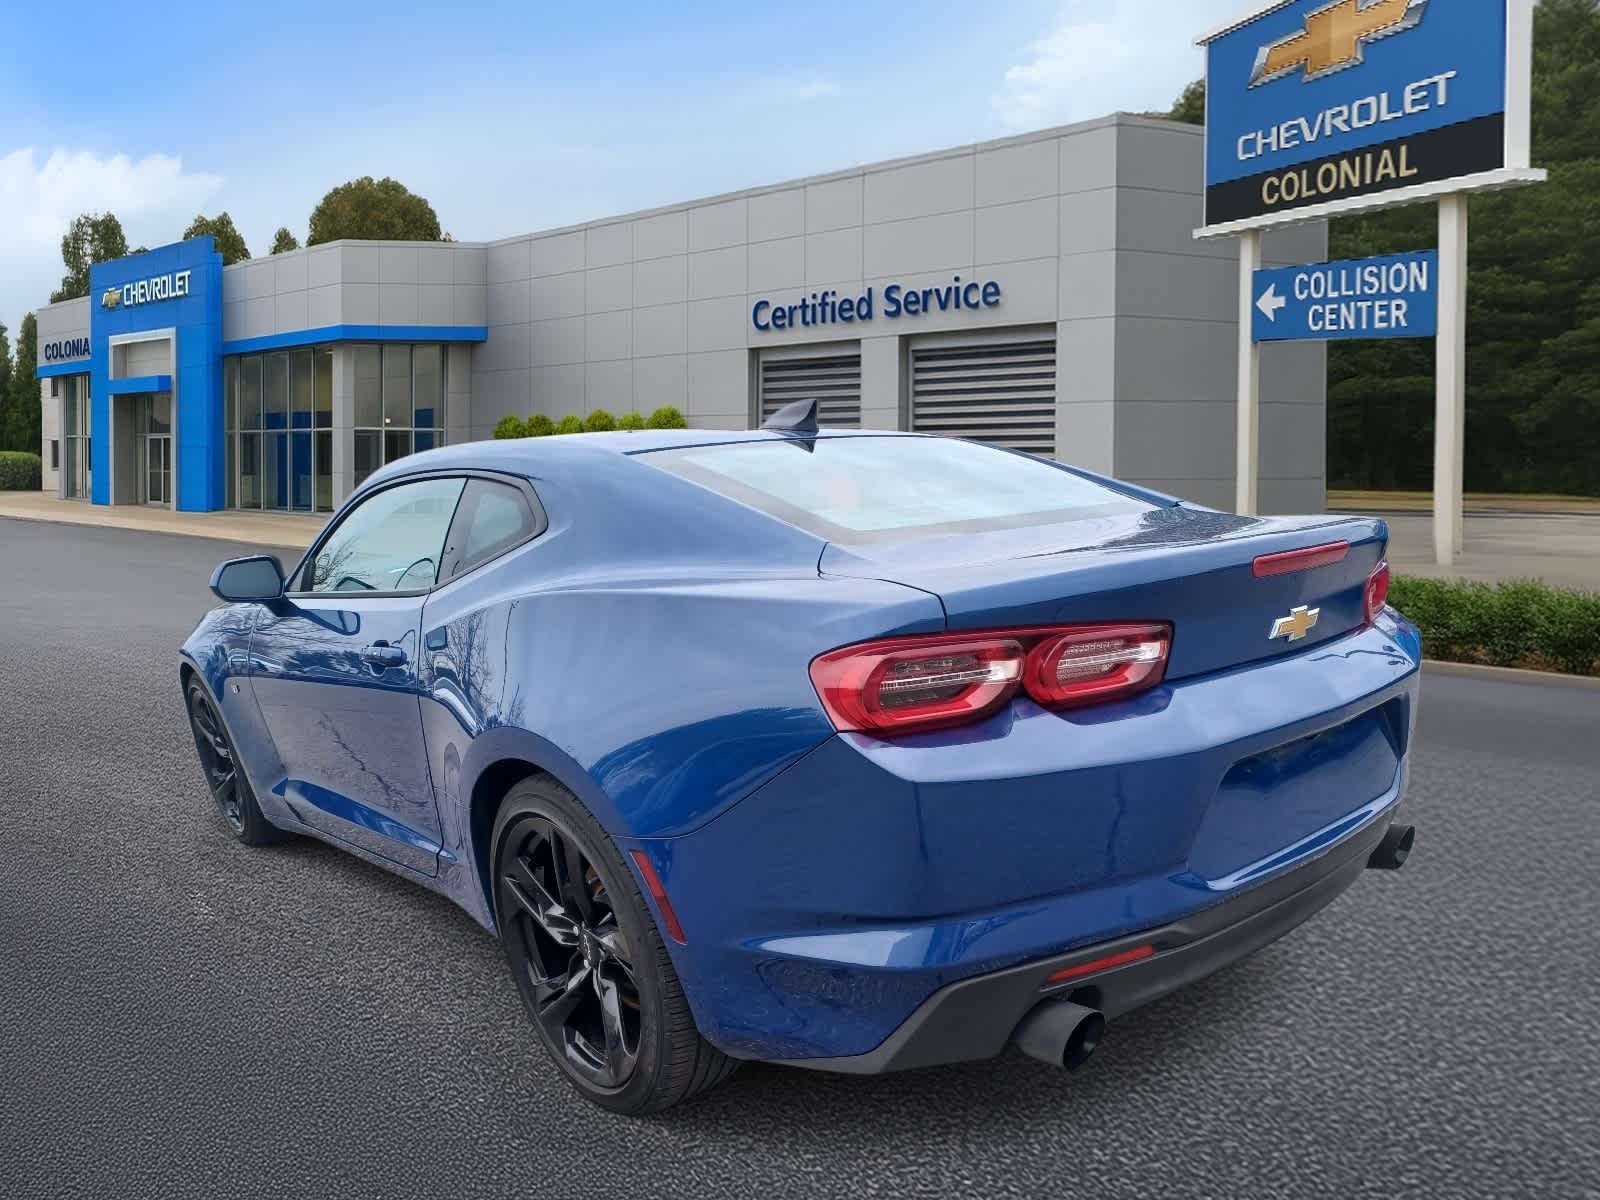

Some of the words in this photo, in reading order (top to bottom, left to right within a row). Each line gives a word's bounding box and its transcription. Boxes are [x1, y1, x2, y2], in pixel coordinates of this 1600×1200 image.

[1236, 69, 1457, 161] CHEVROLET
[1261, 144, 1418, 206] COLONIAL
[123, 269, 191, 306] CHEVROLET
[752, 286, 873, 331] Certified
[883, 276, 1001, 319] Service
[1294, 260, 1428, 301] COLLISION
[1308, 299, 1408, 332] CENTER
